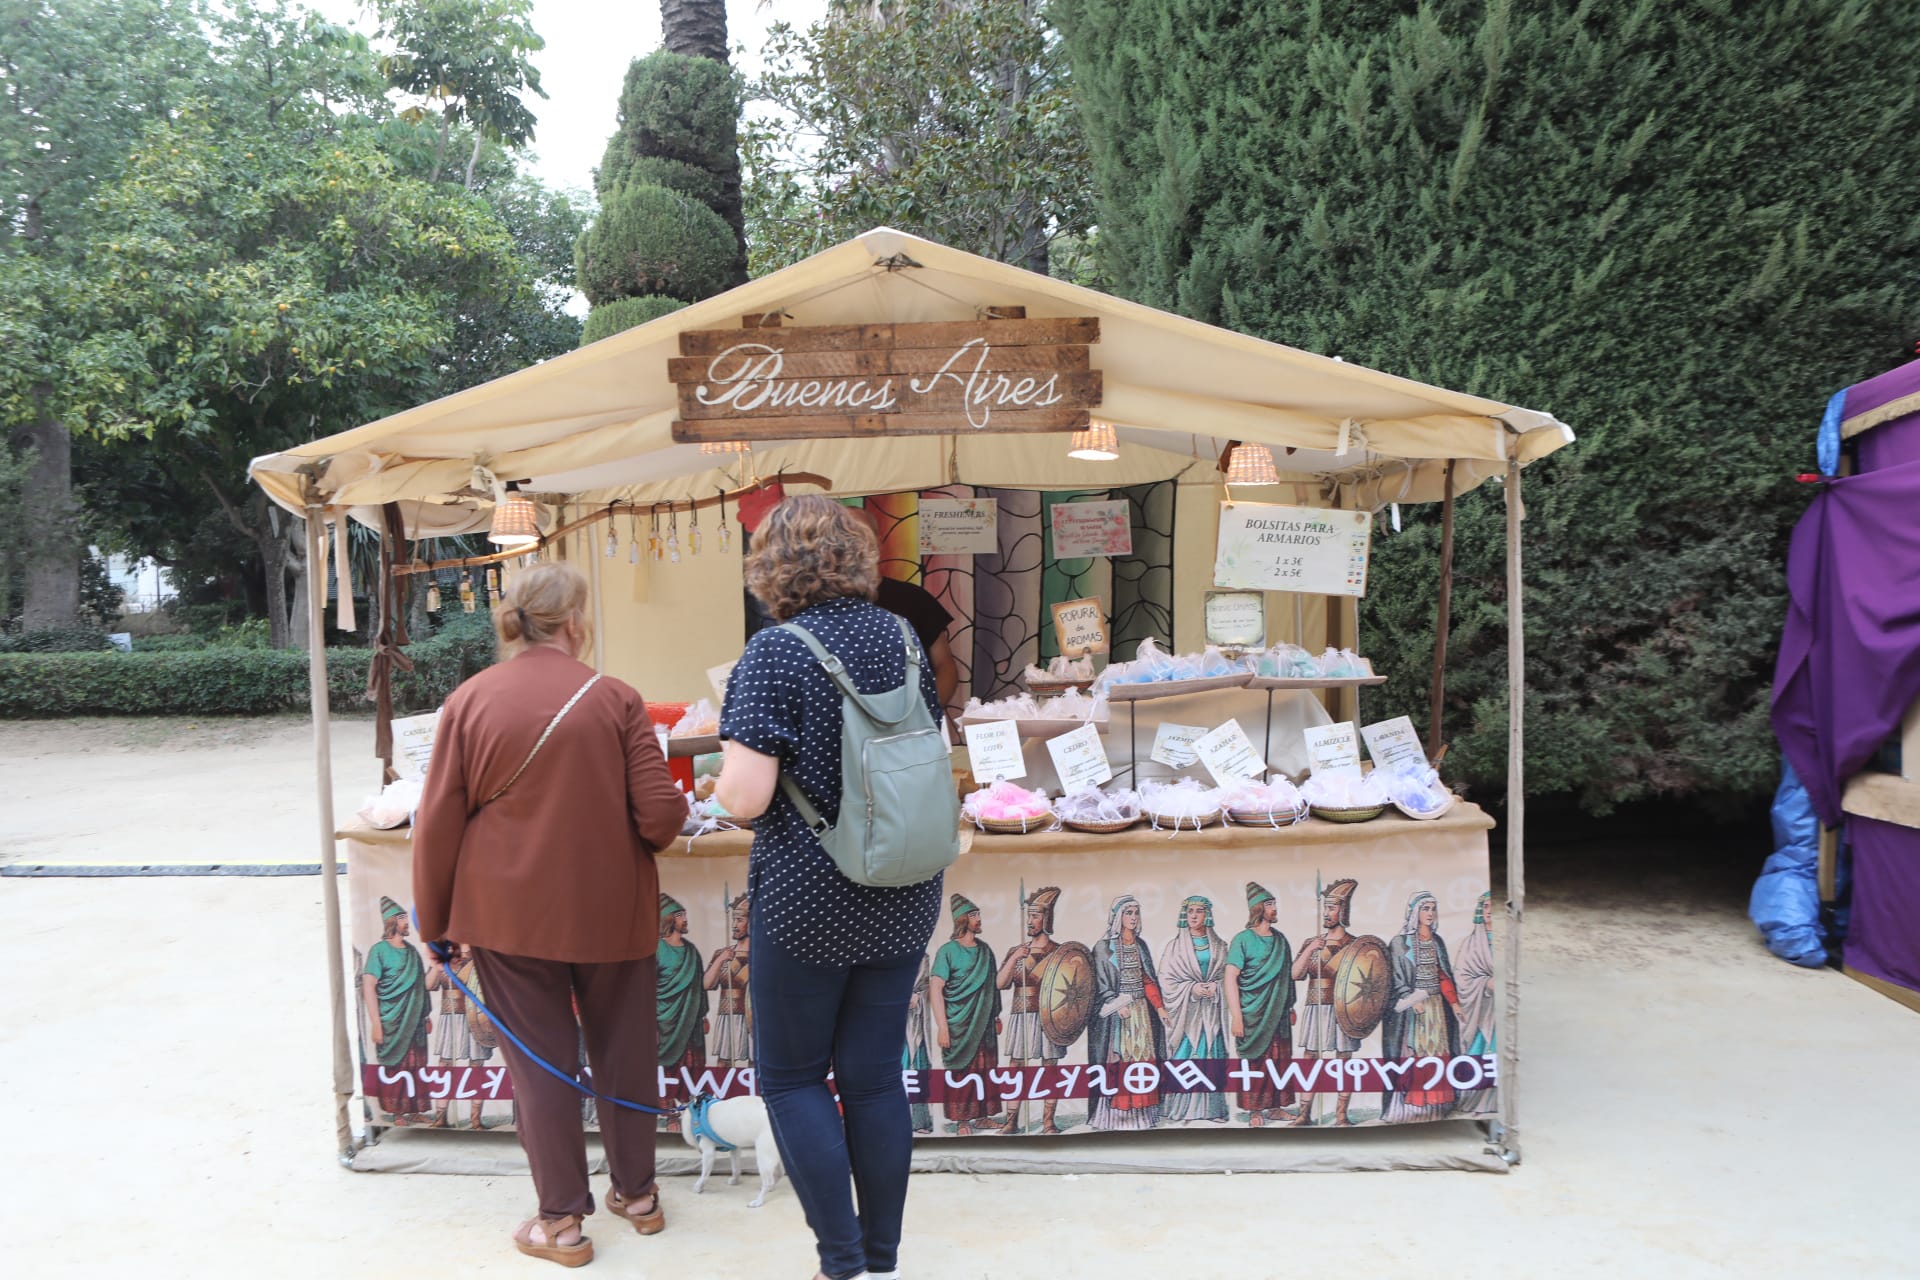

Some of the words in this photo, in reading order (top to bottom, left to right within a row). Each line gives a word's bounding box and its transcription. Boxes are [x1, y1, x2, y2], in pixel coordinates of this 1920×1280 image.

[696, 343, 896, 410] Buenos
[910, 338, 1063, 428] Aires
[1245, 519, 1301, 532] BOLSITAS
[1303, 522, 1334, 534] PARA
[1257, 533, 1321, 546] ARMARIOS
[1275, 556, 1281, 565] 1
[1290, 557, 1304, 567] 3€
[1274, 567, 1281, 577] 2
[1290, 568, 1303, 578] 5€
[1066, 631, 1103, 648] AROMAS
[975, 731, 994, 740] FLOR
[1063, 740, 1088, 754] CEDRO
